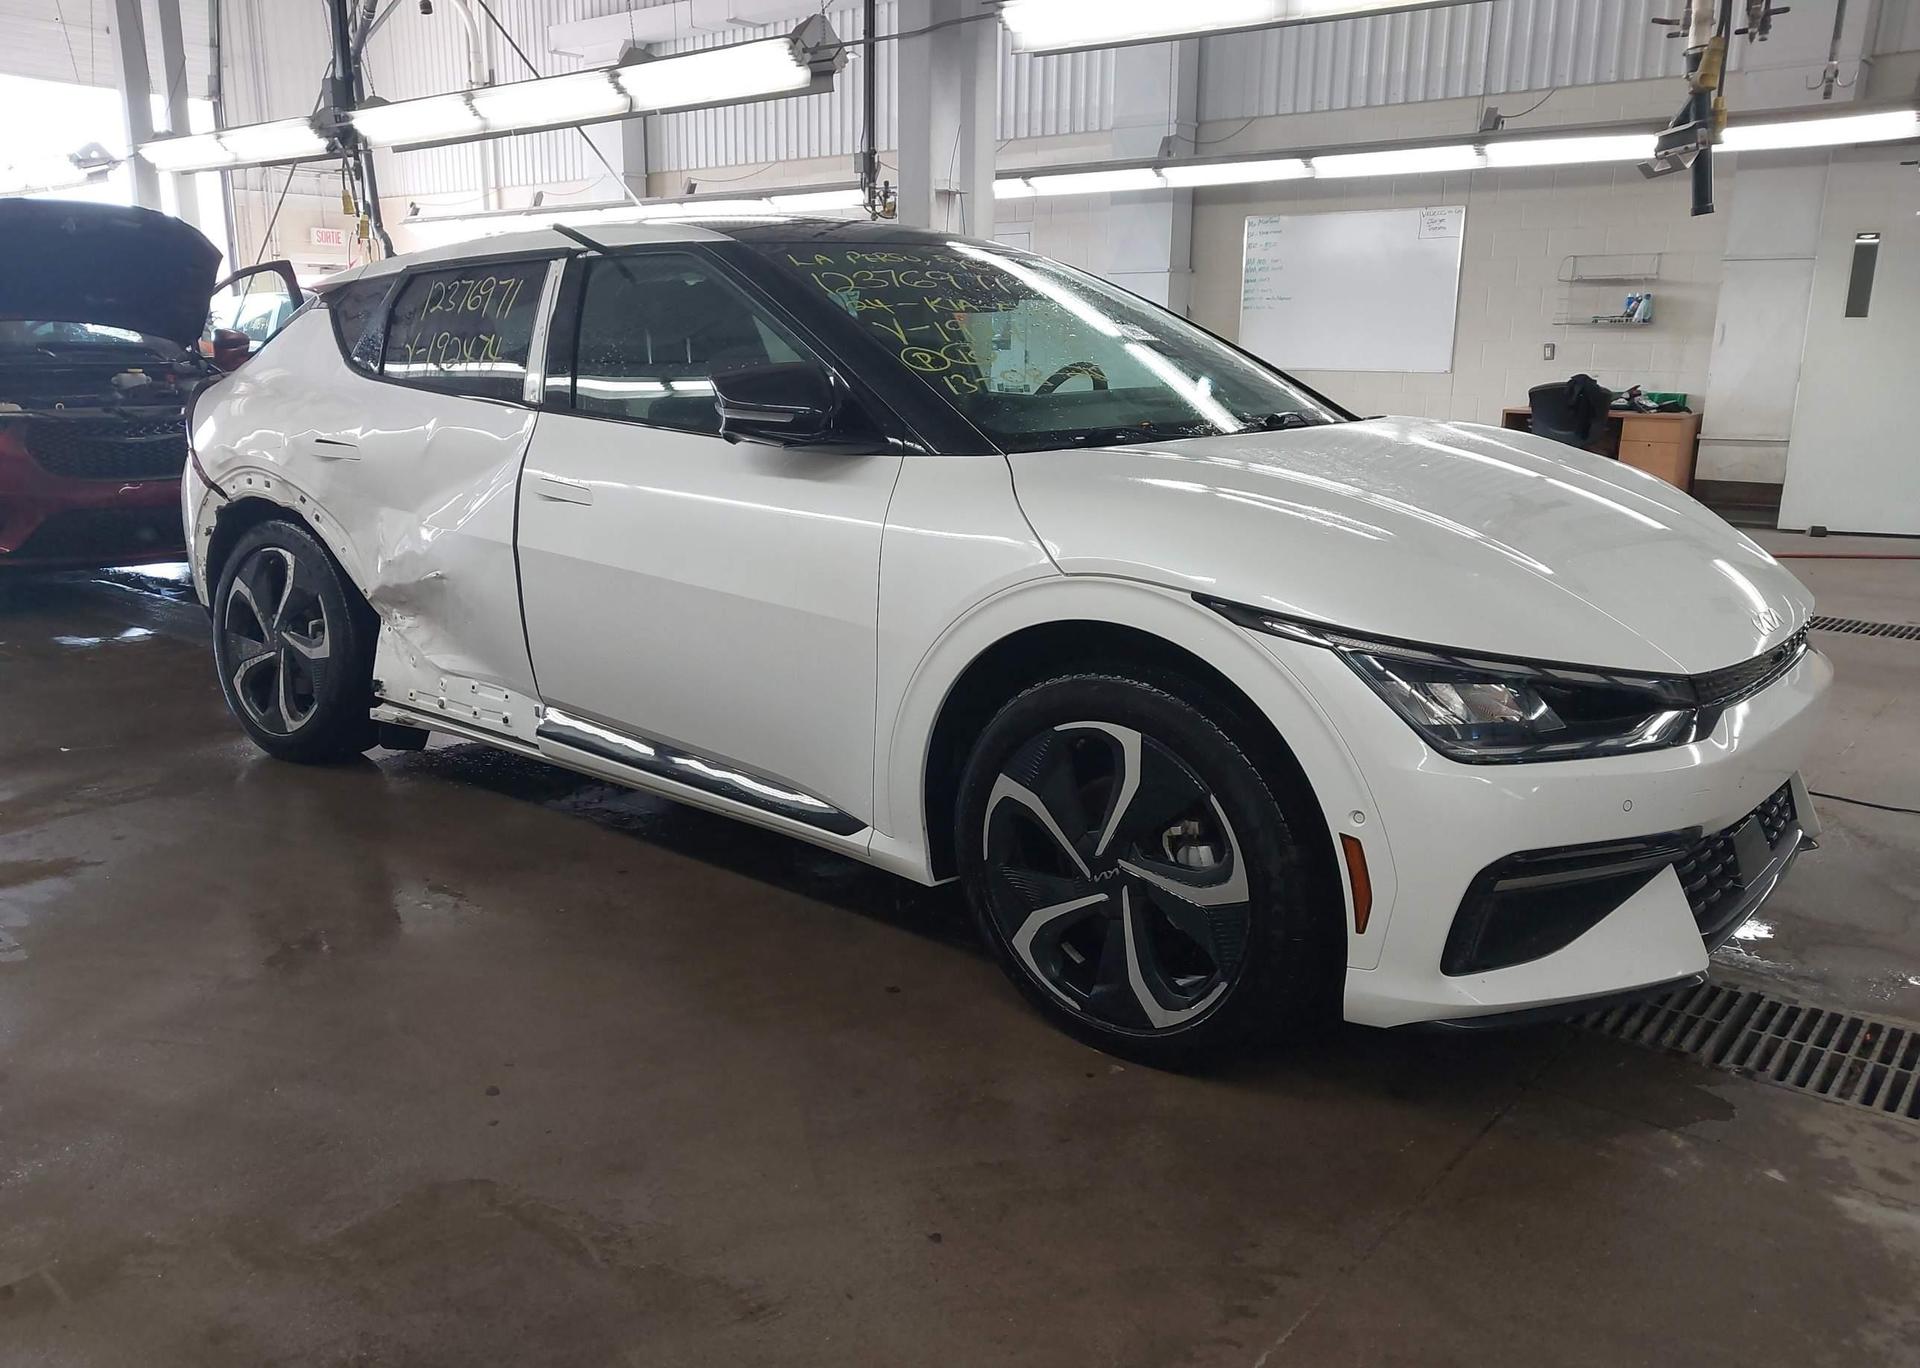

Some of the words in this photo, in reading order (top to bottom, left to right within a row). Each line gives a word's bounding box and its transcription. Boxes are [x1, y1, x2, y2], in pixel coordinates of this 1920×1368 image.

[315, 231, 342, 245] SORTIE
[787, 254, 834, 266] LA
[421, 276, 524, 320] 12376971
